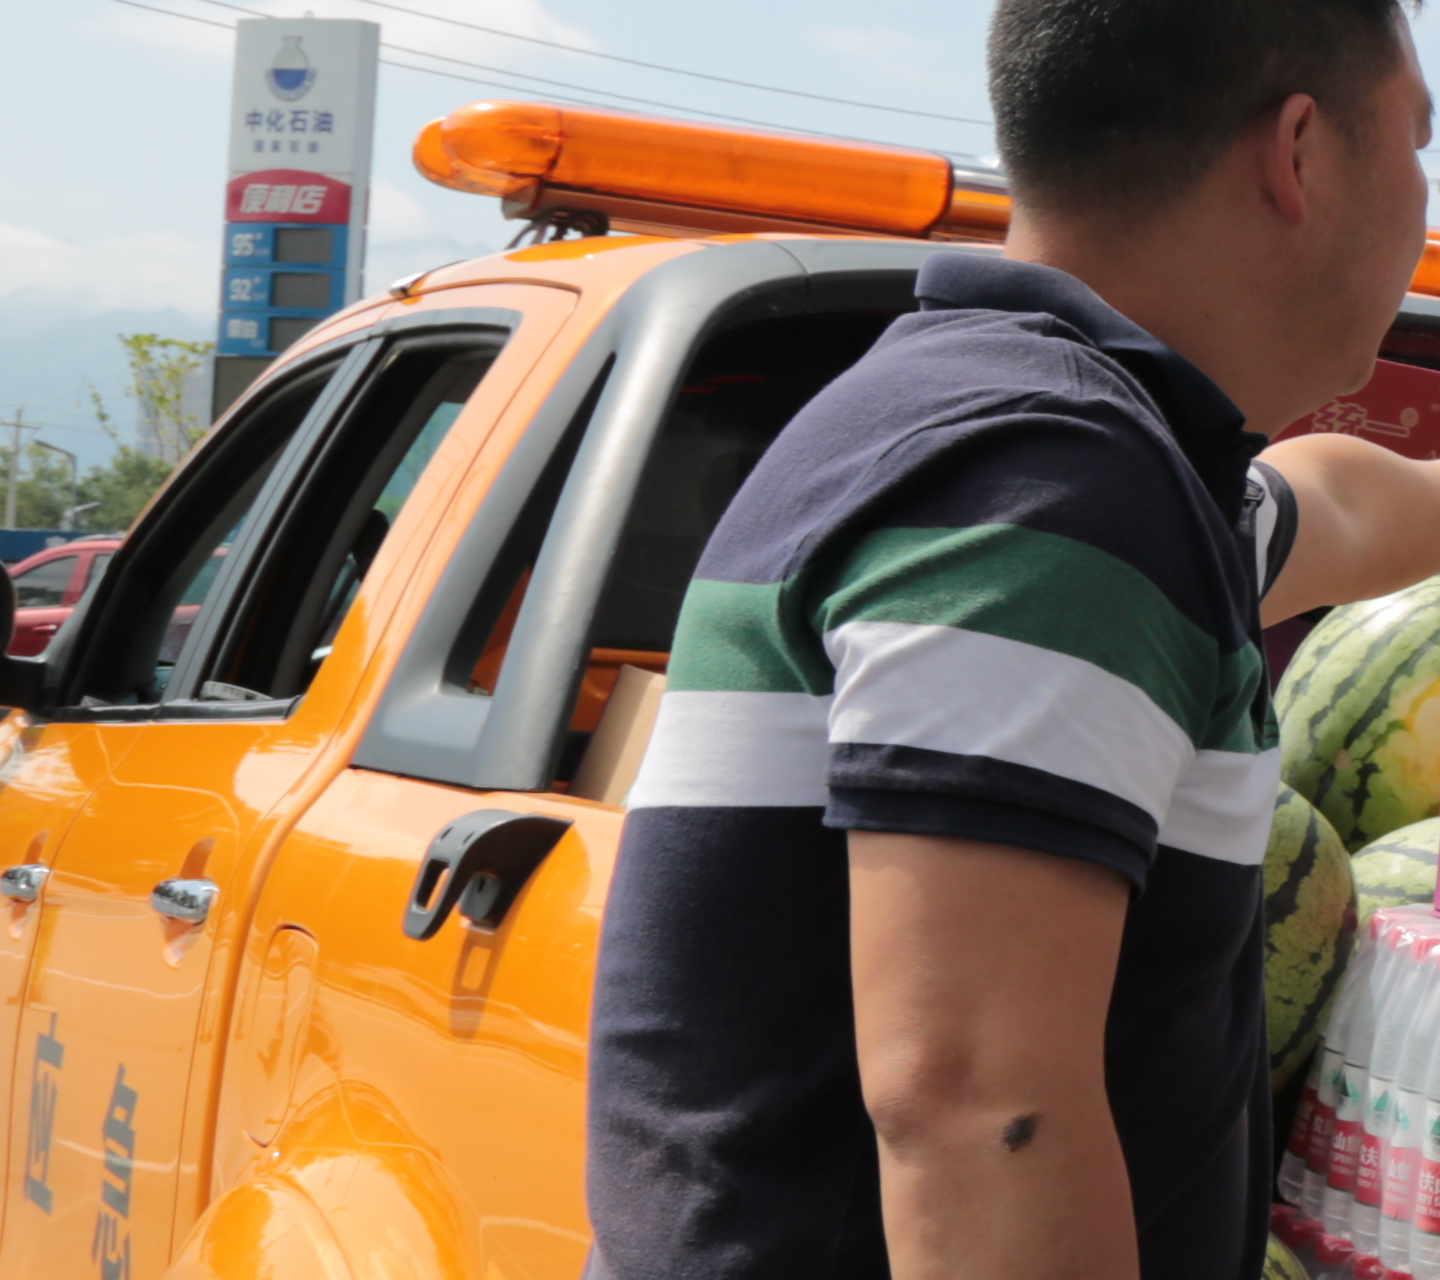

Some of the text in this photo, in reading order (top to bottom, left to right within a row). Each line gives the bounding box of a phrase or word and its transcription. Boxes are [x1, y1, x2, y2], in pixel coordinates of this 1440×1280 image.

[245, 109, 334, 134] 中化石油
[239, 183, 329, 215] 便利店
[1310, 397, 1411, 438] 统一
